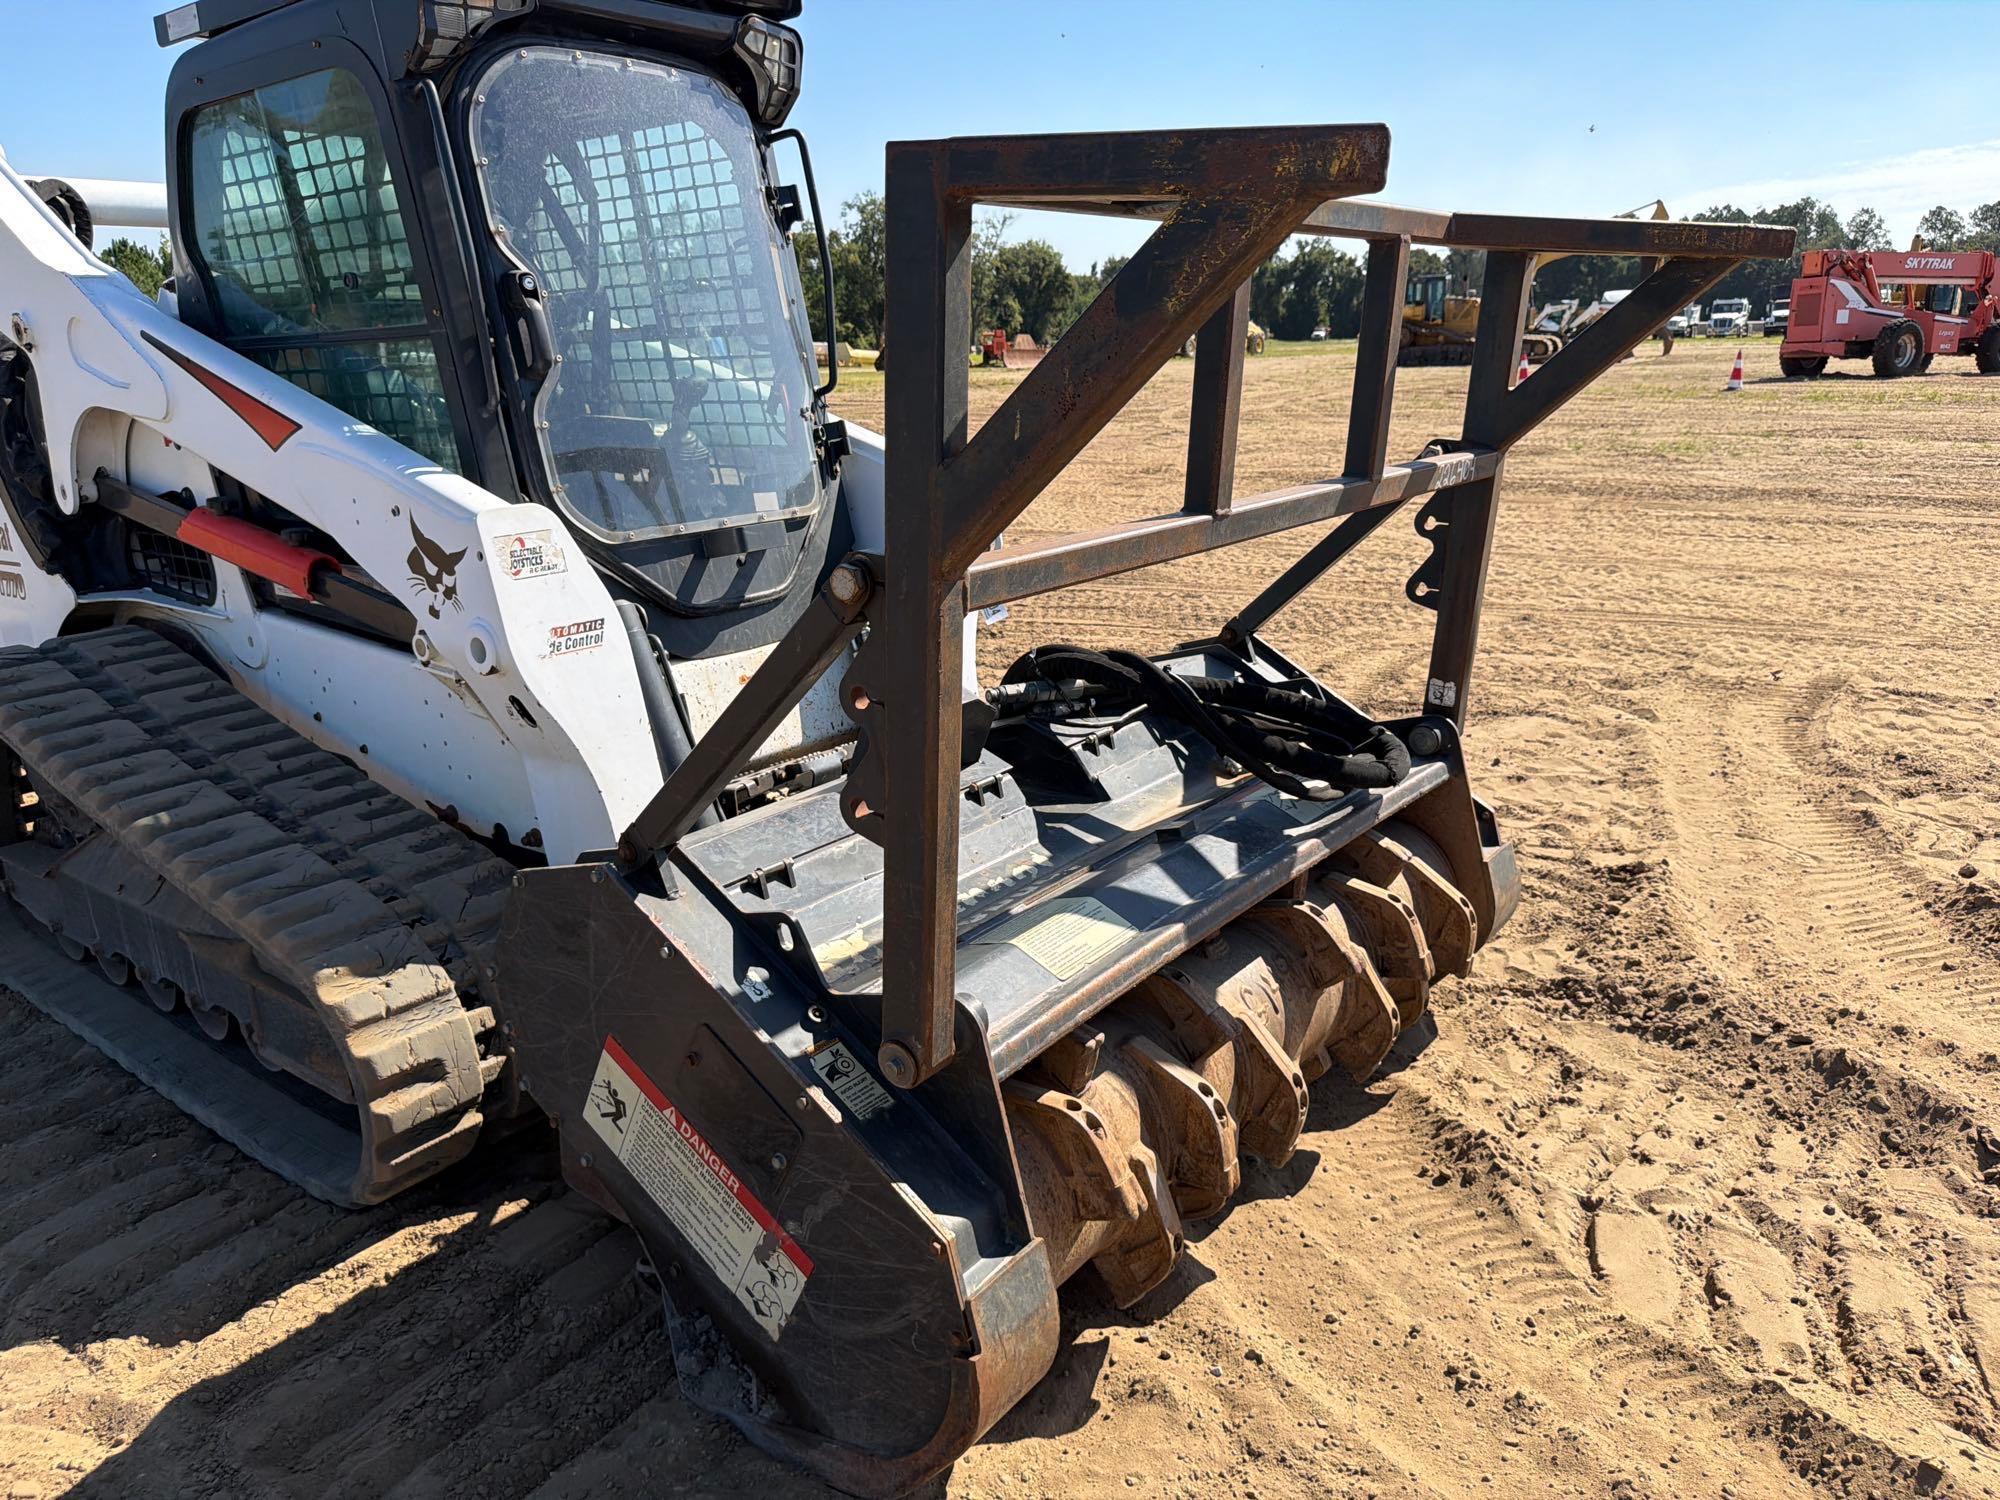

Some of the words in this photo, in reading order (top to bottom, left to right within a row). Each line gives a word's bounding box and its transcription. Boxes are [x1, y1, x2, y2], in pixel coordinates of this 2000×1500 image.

[1904, 257, 1955, 270] SKYTRAK
[1435, 457, 1476, 489] 226404
[510, 555, 543, 570] JOYSTICKS
[565, 631, 604, 650] Control
[668, 1125, 695, 1159] OBJECTS
[705, 1167, 735, 1203] ROTATING
[679, 1120, 740, 1194] DANGER
[653, 1117, 673, 1143] CAUSE
[673, 1140, 699, 1172] SERIOUS
[731, 1206, 752, 1232] DEATH
